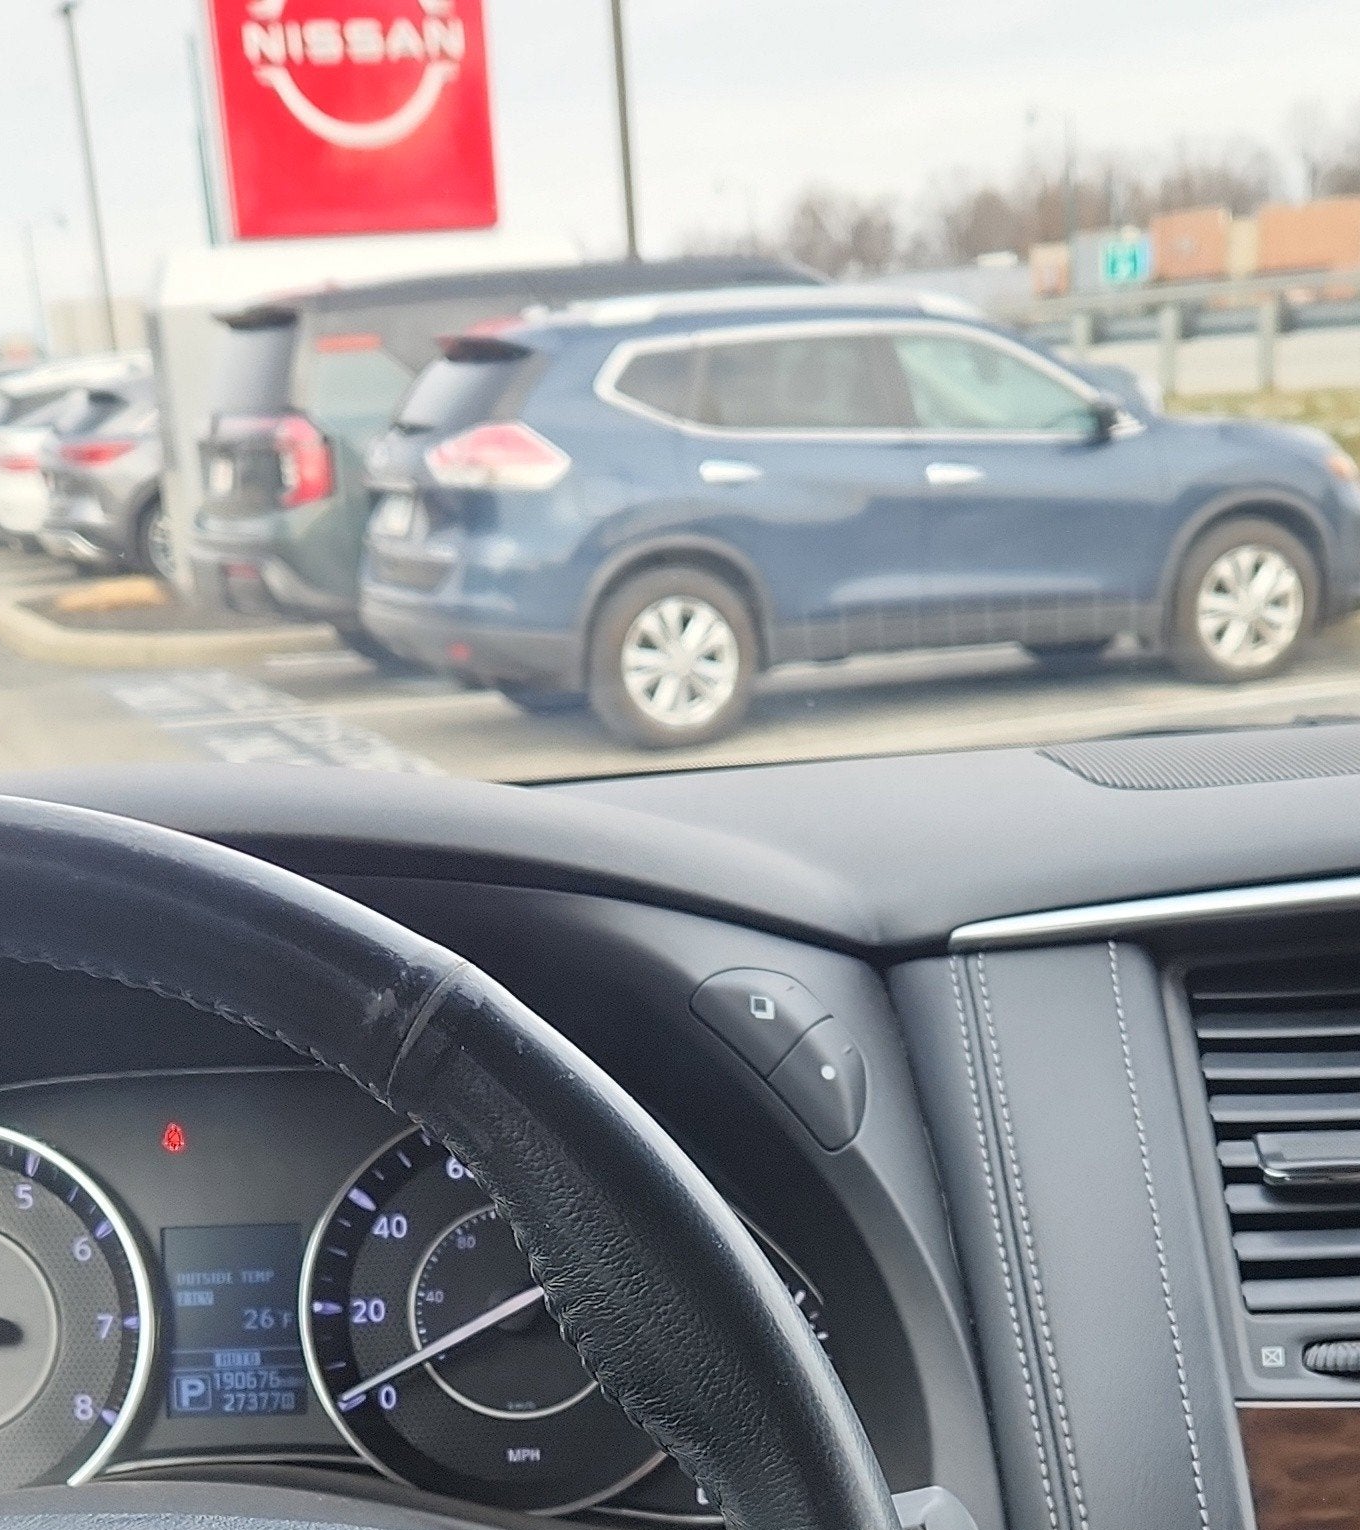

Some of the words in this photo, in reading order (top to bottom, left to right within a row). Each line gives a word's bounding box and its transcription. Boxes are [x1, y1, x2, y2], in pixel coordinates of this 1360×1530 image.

[241, 17, 465, 66] NISSAN
[15, 1184, 34, 1209] 5
[371, 1213, 408, 1240] 40
[73, 1236, 91, 1261] 6
[425, 1290, 444, 1303] 40
[243, 1308, 275, 1330] 26
[352, 1299, 386, 1324] 20
[96, 1315, 114, 1340] 7
[180, 1378, 205, 1408] P
[379, 1385, 397, 1410] 0
[73, 1395, 93, 1421] 8
[506, 1448, 541, 1463] MPH
